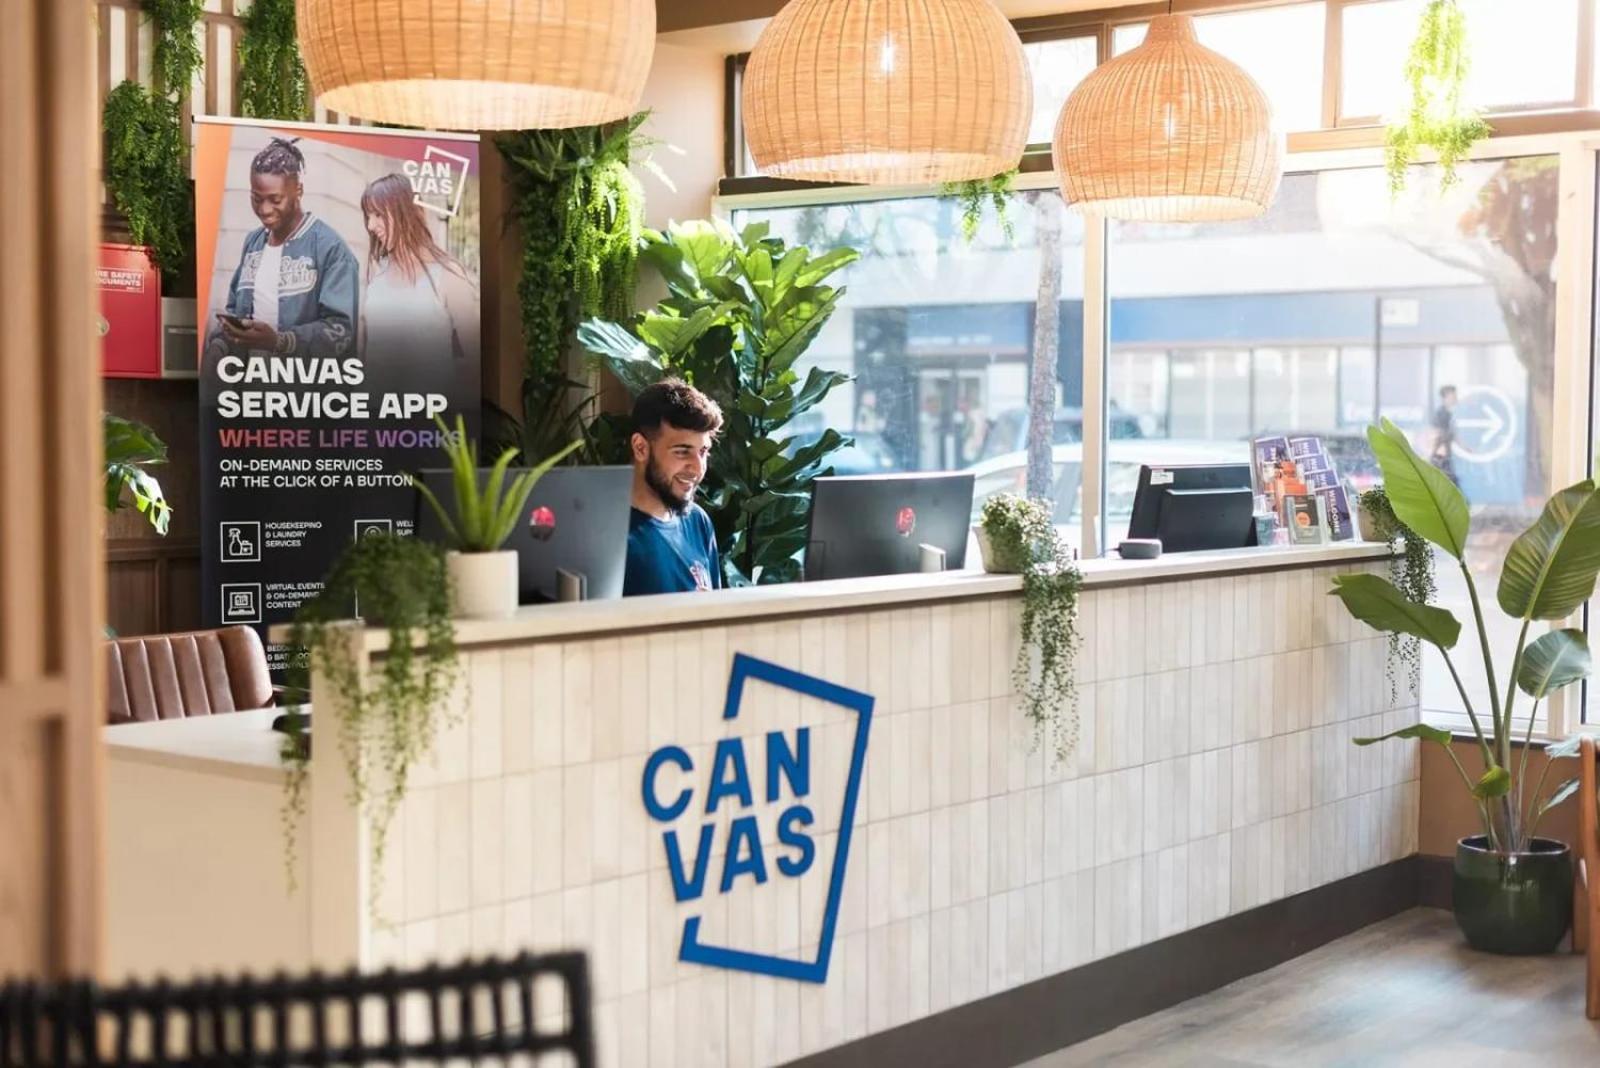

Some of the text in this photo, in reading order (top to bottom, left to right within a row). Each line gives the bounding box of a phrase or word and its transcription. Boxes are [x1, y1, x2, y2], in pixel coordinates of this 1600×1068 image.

[403, 160, 450, 178] CAN
[409, 177, 453, 195] VAS
[111, 271, 142, 280] SAFETY
[217, 356, 364, 385] CANVAS
[217, 390, 448, 419] SERVICE APP
[219, 429, 311, 448] WHERE
[319, 429, 369, 448] LIFE
[220, 459, 383, 472] ON-DEMAND SERVICES
[220, 475, 413, 488] AT THE CLICK OF A BUTTON
[265, 521, 322, 530] HOUSEKEEPING
[272, 530, 307, 538] LAUNDRY
[265, 540, 302, 548] SERVICES
[266, 583, 296, 591] VIRTUAL
[266, 601, 302, 609] CONTENT
[641, 726, 810, 823] CAN
[662, 805, 816, 903] VAS
